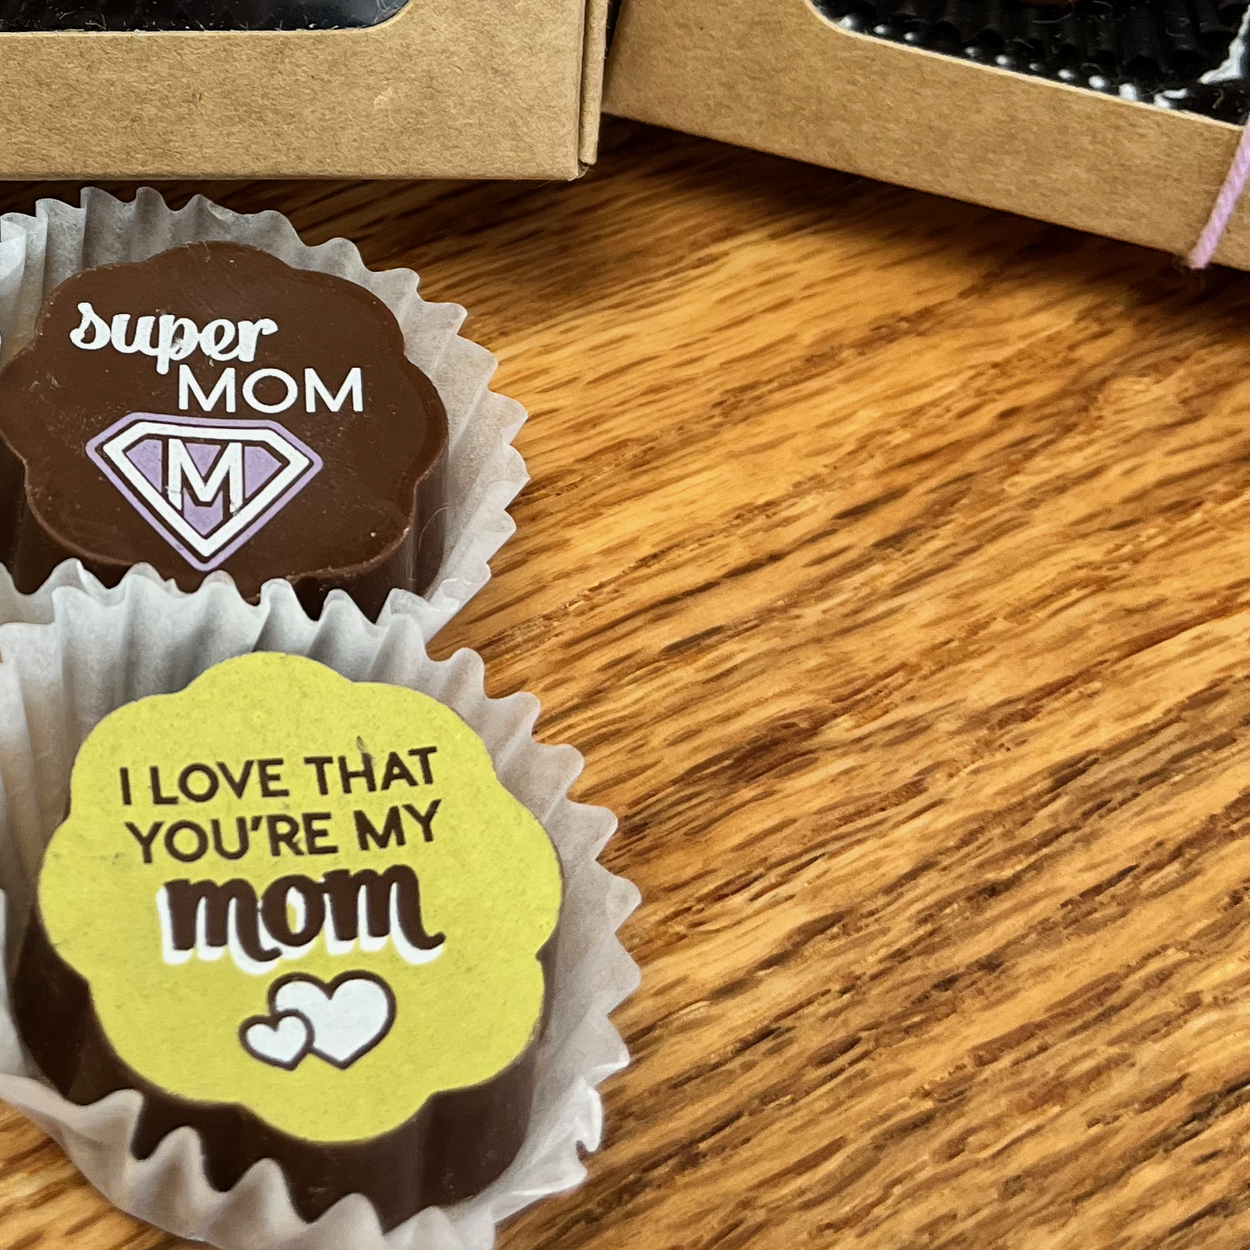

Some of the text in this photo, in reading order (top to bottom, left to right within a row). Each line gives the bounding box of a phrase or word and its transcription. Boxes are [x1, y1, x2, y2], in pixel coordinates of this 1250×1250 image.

[69, 302, 278, 375] super
[178, 364, 364, 413] MOM
[167, 438, 244, 514] M
[119, 746, 438, 806] I LOVE THAT
[125, 799, 442, 864] YOU'RE MY
[159, 864, 446, 968] mom
